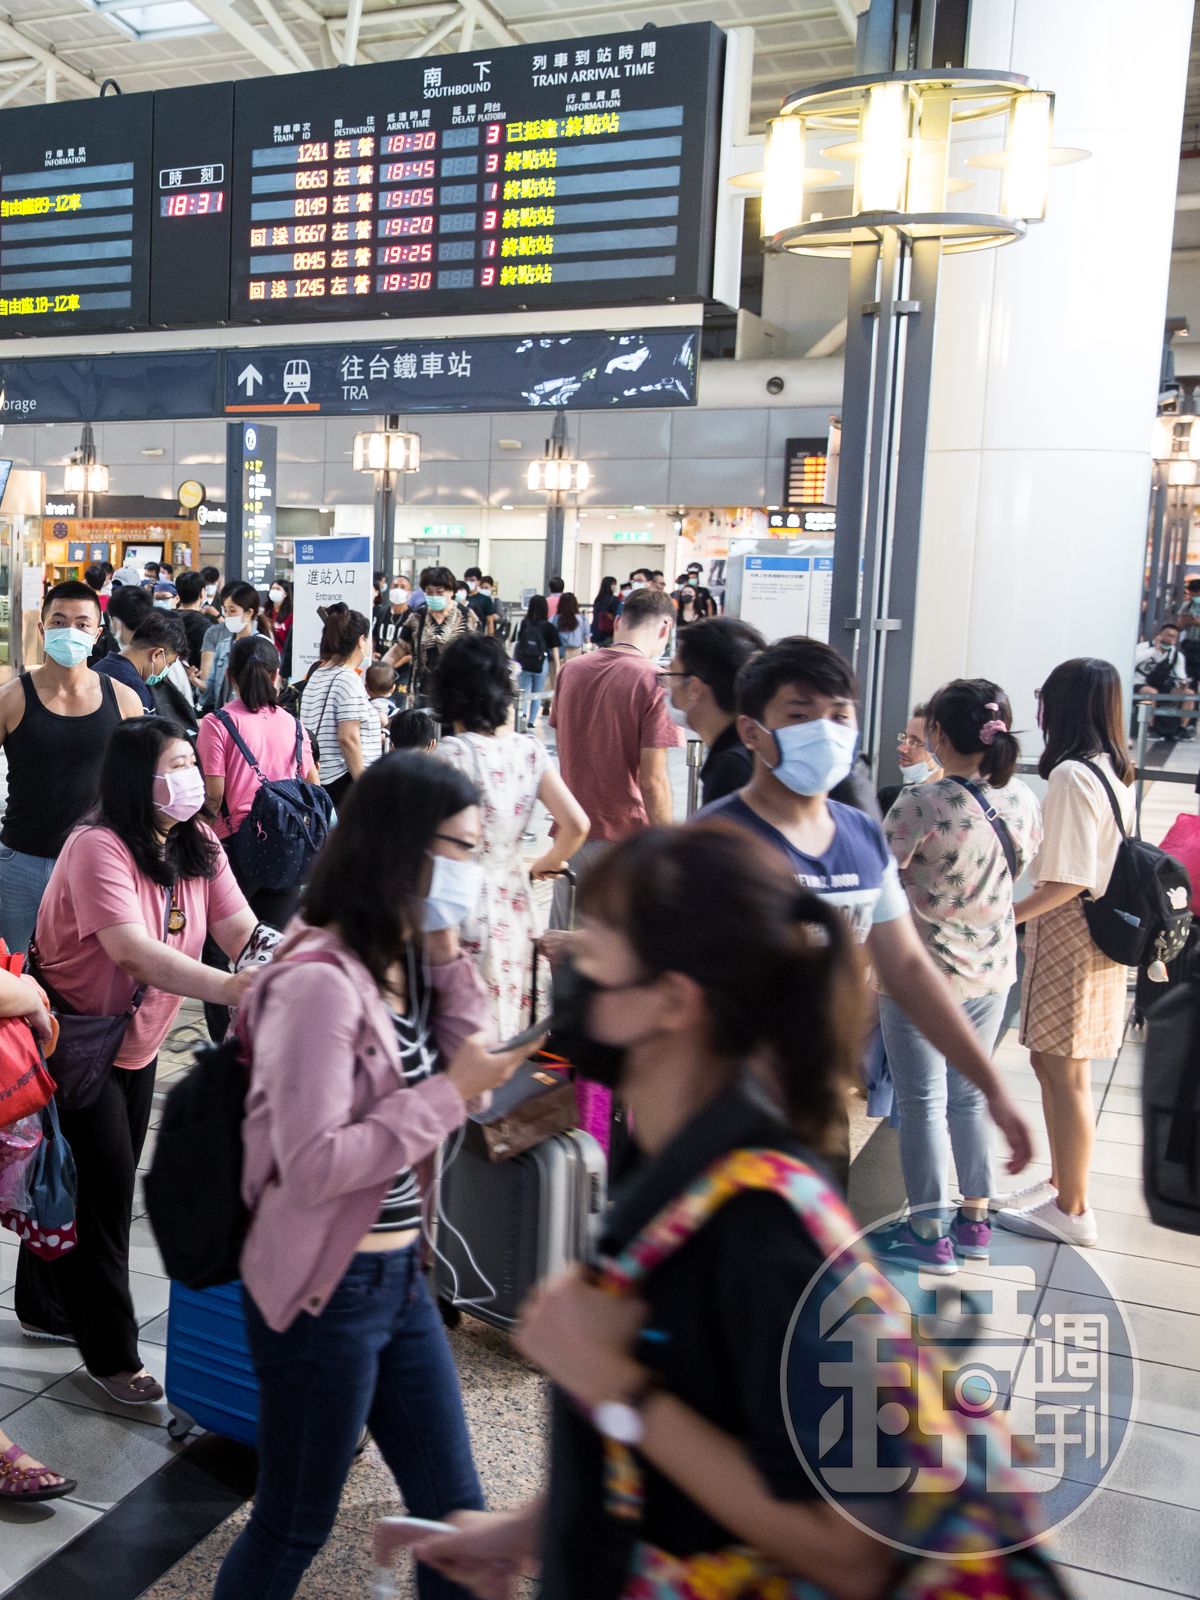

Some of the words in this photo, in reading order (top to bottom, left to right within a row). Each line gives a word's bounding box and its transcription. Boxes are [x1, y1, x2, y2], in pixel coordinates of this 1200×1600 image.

[532, 41, 657, 71] 列車到站時間
[424, 61, 491, 87] 南下
[532, 72, 569, 87] TRAIN
[571, 67, 621, 83] ARRIVAL
[624, 62, 656, 78] TIME
[423, 82, 491, 99] SOUTHBOUND
[565, 100, 621, 112] INFORMATION
[387, 119, 411, 131] ARRVL
[412, 116, 431, 128] TIME
[452, 114, 475, 124] DELAY
[477, 112, 506, 122] PLATFORM
[274, 132, 294, 143] TRAIN
[302, 131, 311, 140] ID
[334, 126, 375, 137] DESTINATION
[297, 142, 328, 162] 1241
[334, 137, 375, 160] 左營
[387, 131, 436, 152] 18:30
[486, 125, 500, 144] 3
[45, 156, 86, 167] INFORMATION
[296, 170, 328, 190] 0663
[333, 164, 374, 187] 左營
[386, 160, 435, 180] 18:45
[486, 154, 499, 173] 3
[504, 148, 557, 172] 終點站
[169, 167, 214, 186] 時刻
[168, 192, 224, 216] 18:31
[295, 197, 327, 216] 0149
[333, 192, 373, 214] 左營
[386, 188, 434, 207] 19:05
[503, 177, 556, 200] 終點站
[251, 227, 289, 247] 回送
[294, 224, 327, 243] 0667
[331, 220, 372, 241] 左營
[385, 216, 433, 235] 19:20
[483, 211, 497, 229] 3
[502, 206, 555, 229] 終點站
[330, 247, 371, 268] 左營
[384, 244, 432, 263] 19:25
[501, 235, 554, 257] 終點站
[249, 280, 288, 300] 回送
[294, 278, 325, 297] 1245
[330, 274, 370, 295] 左營
[383, 272, 431, 291] 19:30
[481, 268, 494, 286] 3
[500, 264, 553, 286] 終點站
[341, 350, 471, 381] 往台鐵車站
[342, 385, 369, 400] TRA
[307, 568, 355, 585] 進站入口
[315, 592, 342, 601] Entrance
